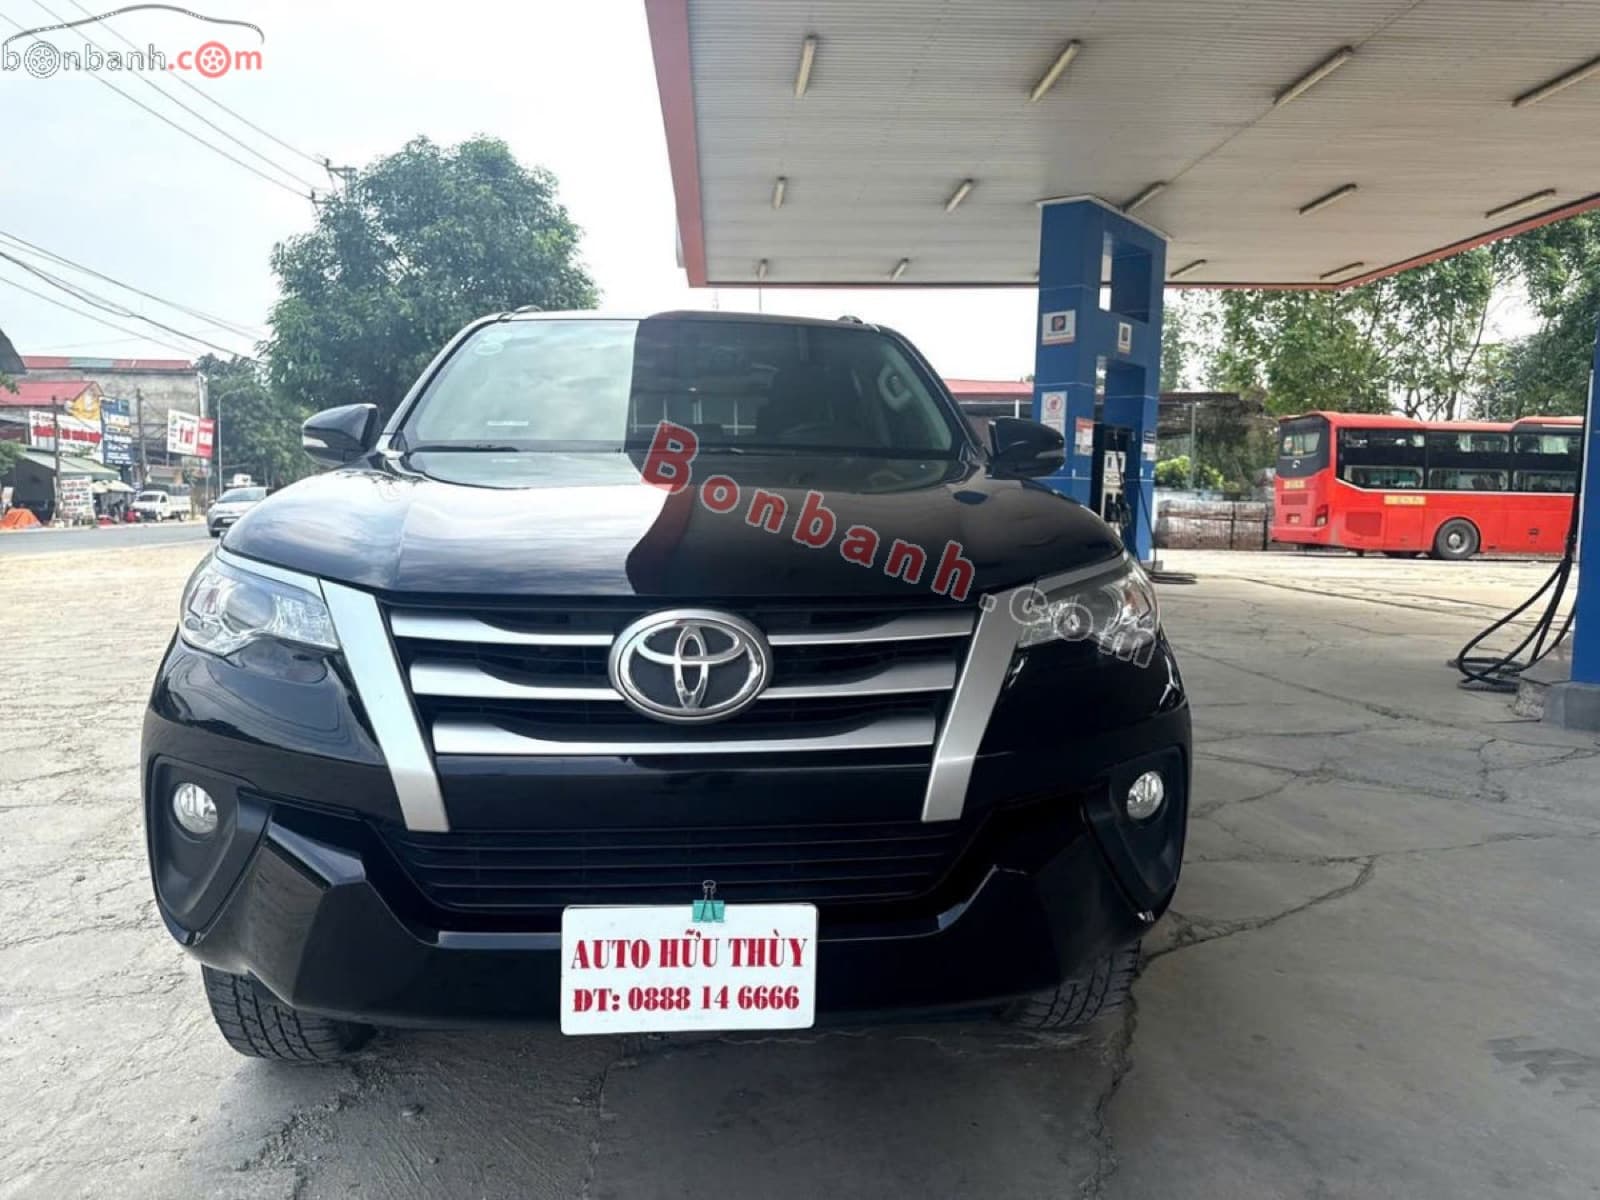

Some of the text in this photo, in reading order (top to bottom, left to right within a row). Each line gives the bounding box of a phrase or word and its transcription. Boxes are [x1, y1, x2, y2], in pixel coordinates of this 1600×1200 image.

[571, 928, 808, 969] AUTO HỮU THÙY
[627, 986, 691, 1012] 0888
[700, 985, 729, 1010] 14
[737, 985, 800, 1010] 6666
